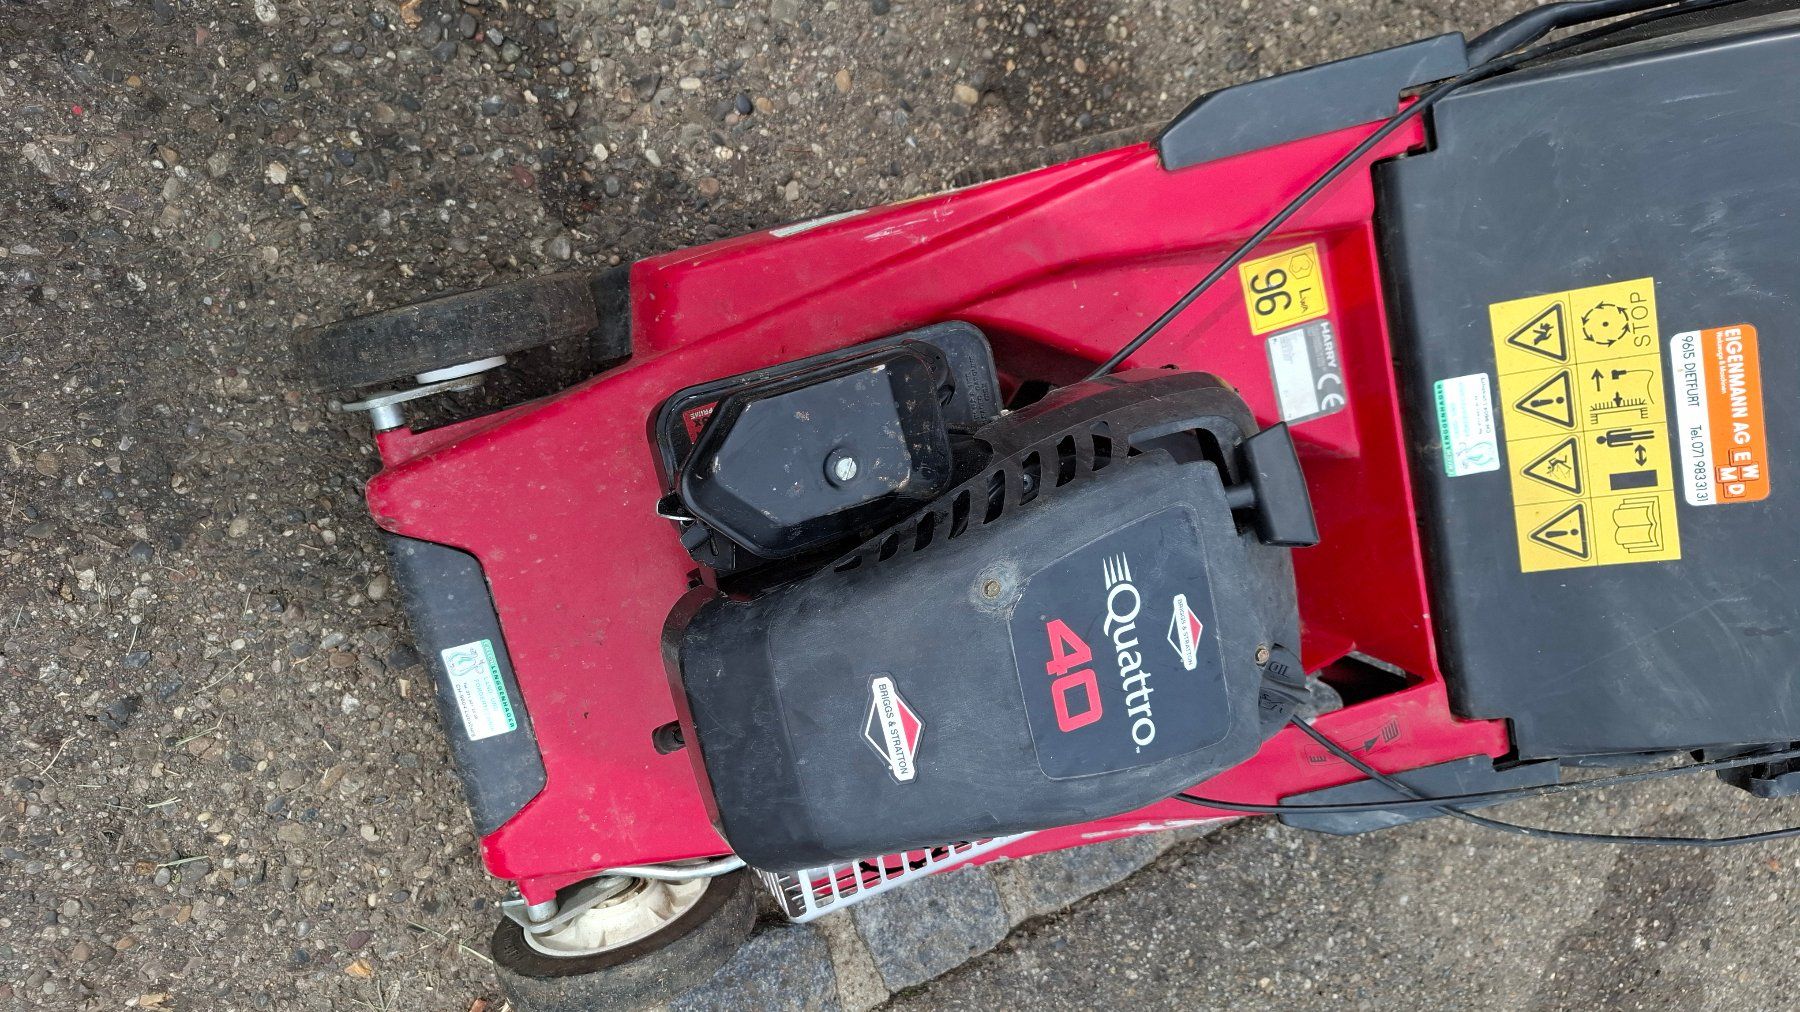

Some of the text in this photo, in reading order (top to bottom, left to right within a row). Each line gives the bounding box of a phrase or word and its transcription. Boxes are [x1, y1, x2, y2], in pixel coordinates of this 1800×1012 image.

[1250, 268, 1292, 316] 96
[1320, 322, 1337, 368] HARRY
[1630, 292, 1652, 347] STOP
[1682, 335, 1695, 360] 9615
[1684, 363, 1699, 407] DIETFURT
[1725, 328, 1751, 445] EIGENMANN AG
[1693, 461, 1706, 481] 983
[1178, 599, 1186, 625] BRIGGS
[1183, 632, 1193, 666] STRATTON
[1046, 618, 1103, 733] 40
[1103, 582, 1156, 747] Quattro
[1268, 661, 1290, 679] OIL
[879, 683, 909, 775] BRIGGS & STRATTON
